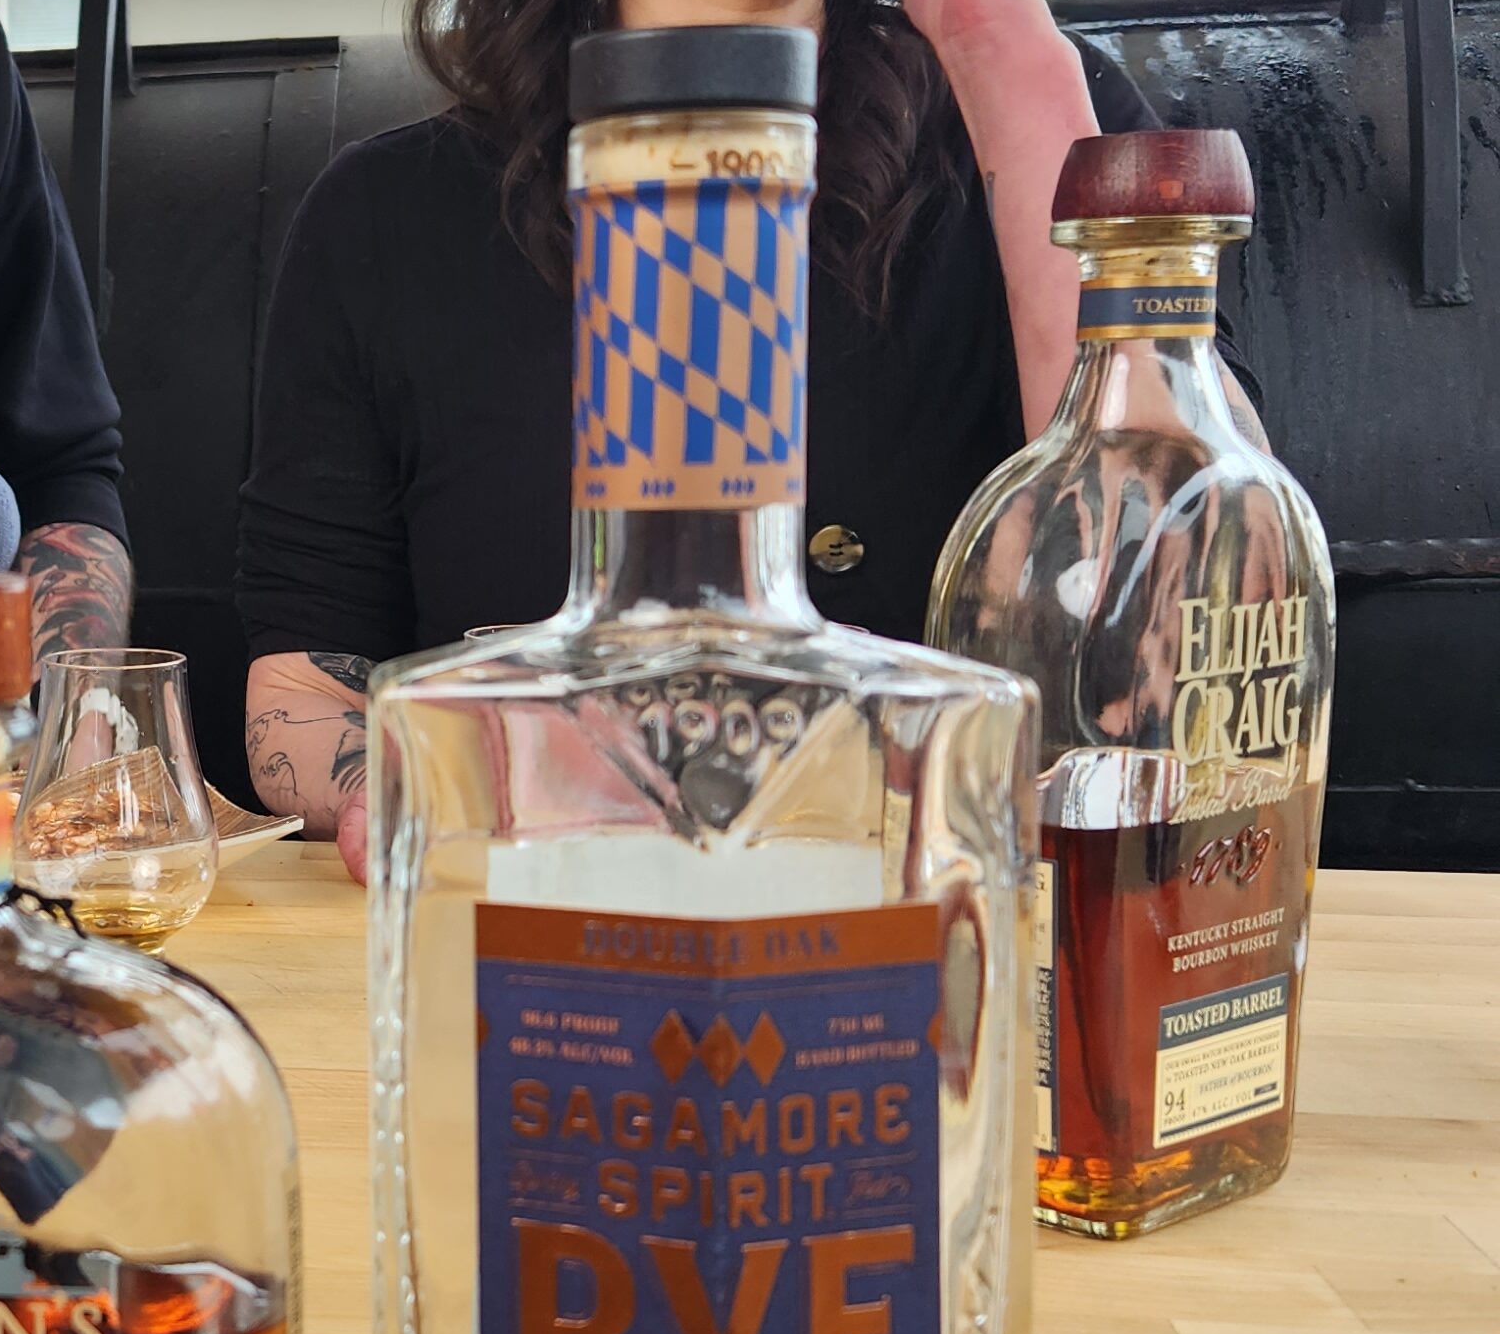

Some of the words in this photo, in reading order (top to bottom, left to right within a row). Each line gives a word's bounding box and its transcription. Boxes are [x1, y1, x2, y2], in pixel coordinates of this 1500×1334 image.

[1176, 596, 1308, 686] ELIJAH
[1173, 674, 1301, 767] CRAIG
[1168, 922, 1229, 953] KENTUCKY
[1231, 907, 1286, 937] STRAIGHT
[1172, 944, 1229, 973] BOURBON
[1230, 930, 1280, 955] WHISKEY
[1163, 1001, 1231, 1039] TOASTED
[1230, 985, 1285, 1020] BARREL
[510, 1077, 912, 1159] SAGAMORE
[1164, 1087, 1187, 1116] 94
[598, 1158, 835, 1230] SPIRIT
